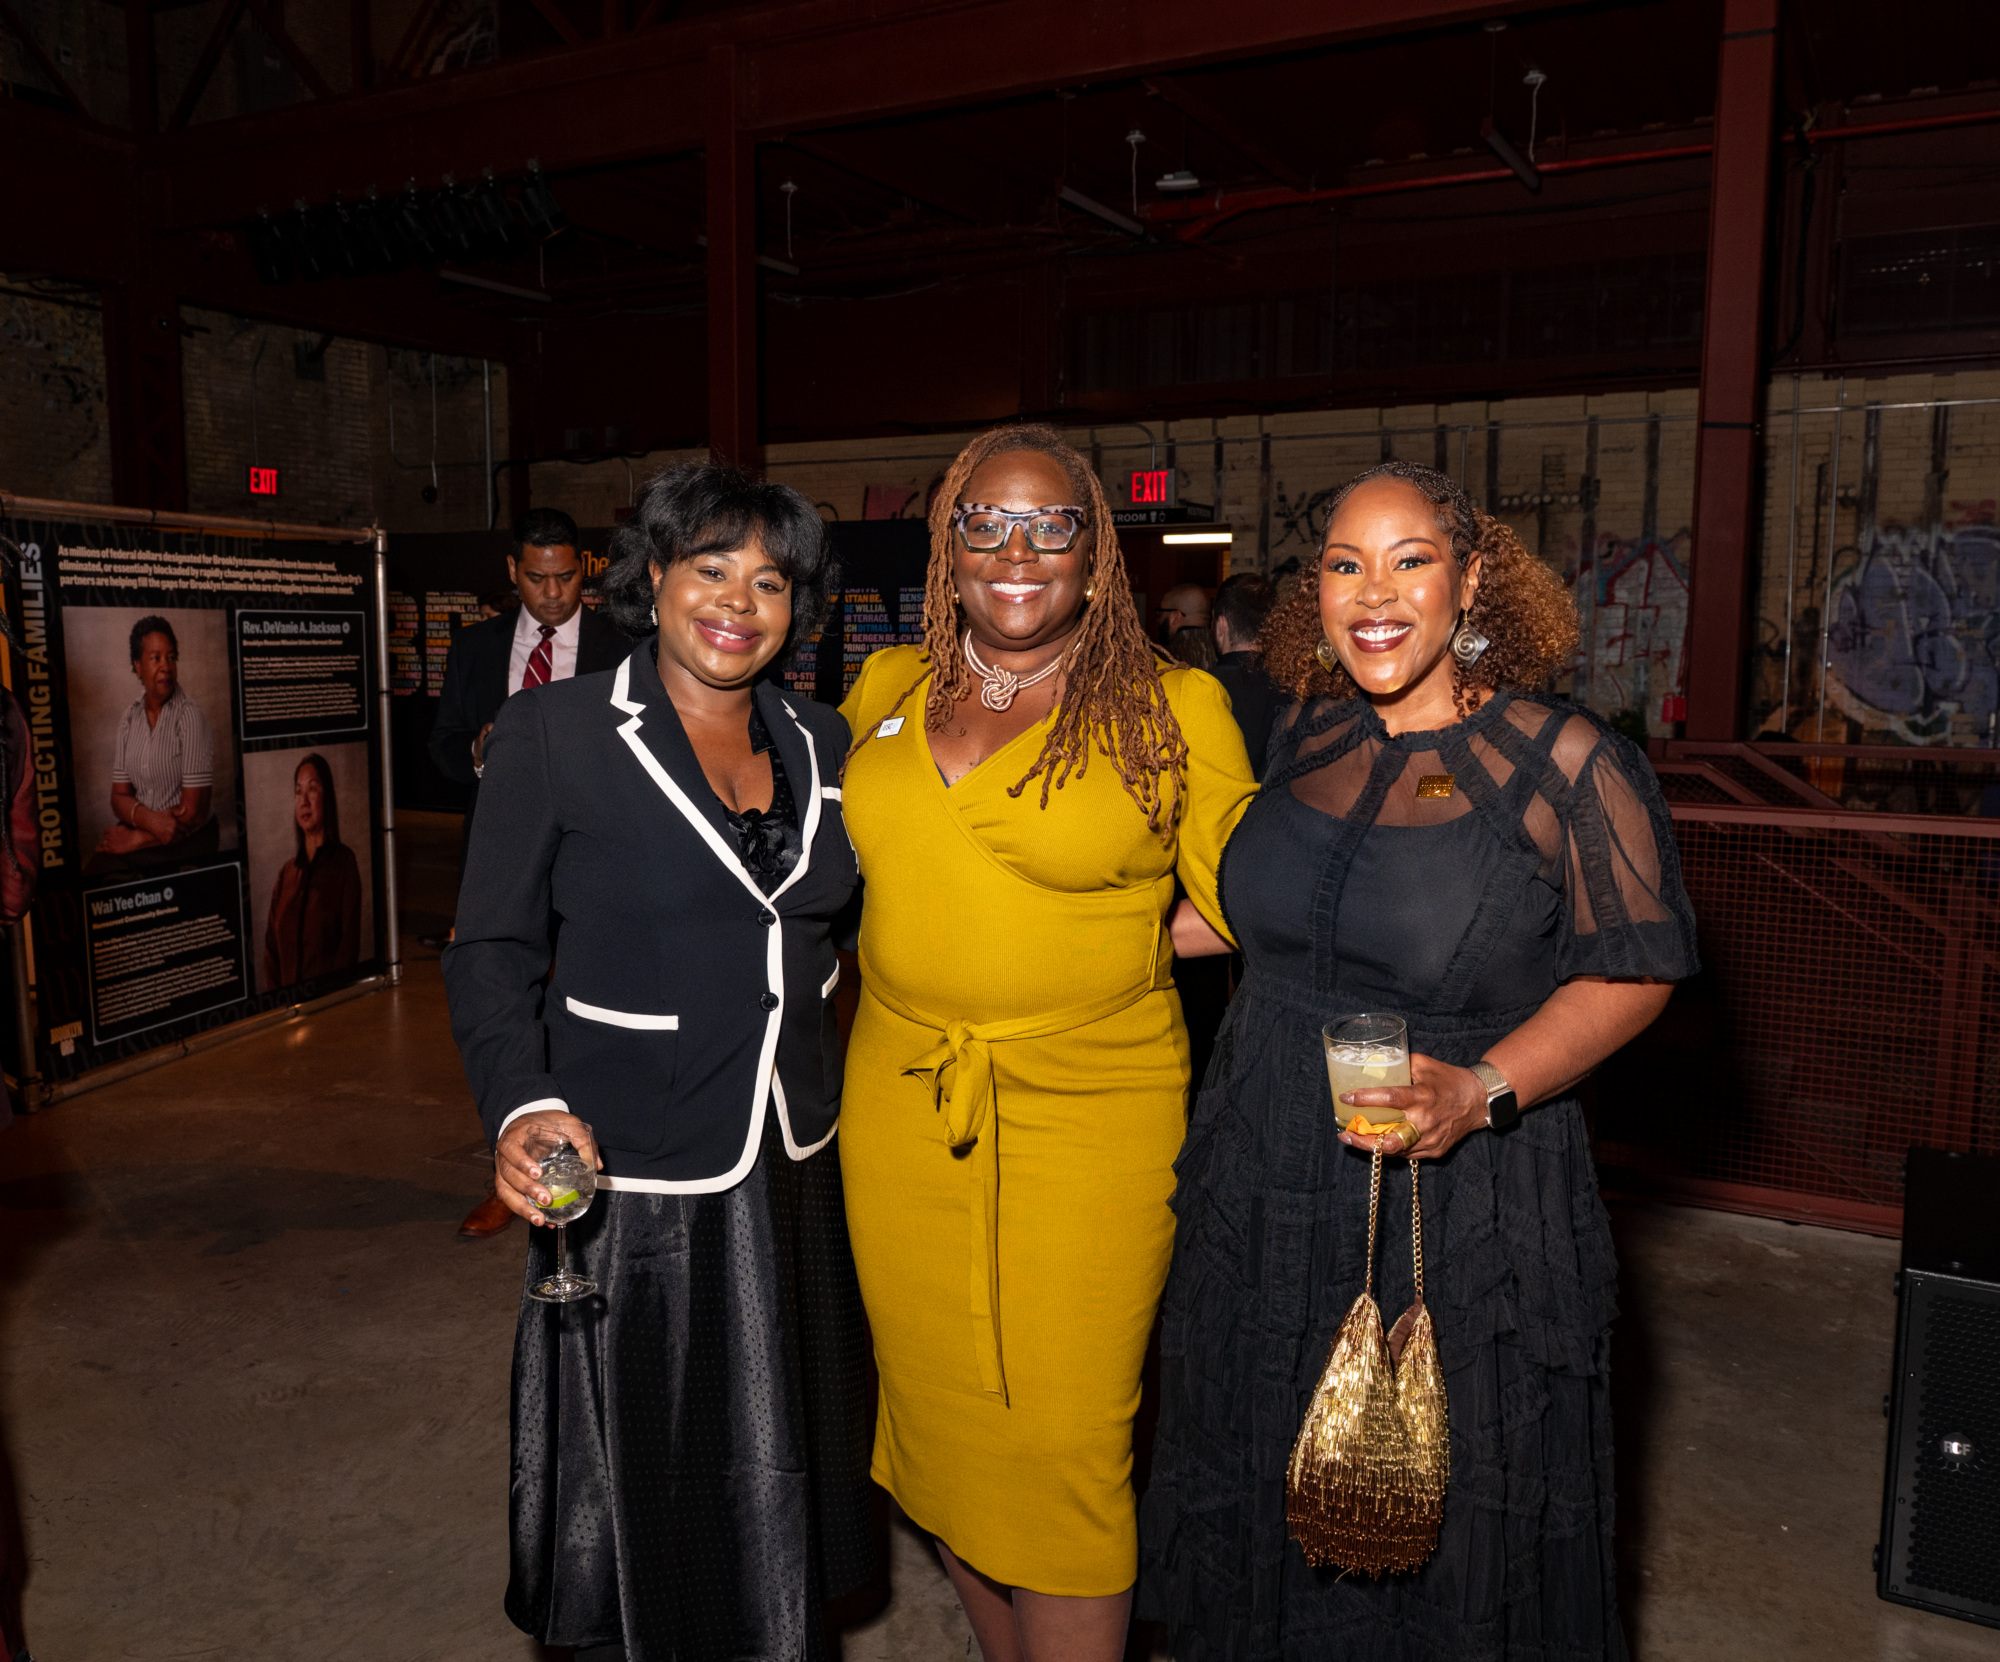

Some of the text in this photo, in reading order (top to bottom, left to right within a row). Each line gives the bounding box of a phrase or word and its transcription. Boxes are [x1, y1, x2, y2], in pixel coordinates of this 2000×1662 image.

[250, 467, 278, 495] EXIT
[1132, 471, 1168, 503] EXIT
[58, 545, 68, 556] As
[69, 546, 101, 558] millions
[102, 548, 110, 559] of
[110, 548, 136, 560] federal
[137, 550, 162, 562] dollars
[163, 552, 202, 565] designated
[202, 554, 212, 564] for
[213, 555, 244, 568] Brooklyn
[244, 558, 283, 569] communities
[283, 559, 298, 570] have
[58, 560, 103, 573] eliminated,
[104, 564, 112, 573] or
[113, 563, 152, 576] essentially
[153, 564, 190, 577] blockaded
[190, 566, 200, 578] by
[200, 567, 224, 580] rapidly
[224, 568, 254, 582] changing
[254, 570, 282, 582] eligibility
[282, 572, 322, 583] requirements,
[323, 573, 348, 585] Brooklyn
[60, 575, 95, 587] partners
[96, 578, 109, 586] are
[109, 576, 138, 590] helping
[138, 577, 148, 588] fill
[148, 578, 160, 588] the
[161, 579, 178, 591] gaps
[178, 578, 190, 590] for
[190, 580, 221, 592] Brooklyn
[221, 581, 247, 592] families
[248, 582, 262, 592] who
[262, 584, 272, 592] are
[273, 584, 303, 595] struggling
[303, 585, 310, 594] to
[869, 594, 883, 603] BE
[20, 541, 49, 679] FAMILIES
[852, 614, 889, 623] TERRACE
[243, 620, 341, 634] Rev. DeVanie A. Jackson
[858, 624, 888, 632] DITMAS
[852, 634, 884, 642] BERGEN
[885, 634, 898, 642] BE
[28, 684, 64, 870] PROTECTING
[91, 892, 162, 916] Wai Yee Chan
[124, 910, 156, 924] Community
[156, 906, 180, 916] Services
[1943, 1440, 1972, 1456] RCF
